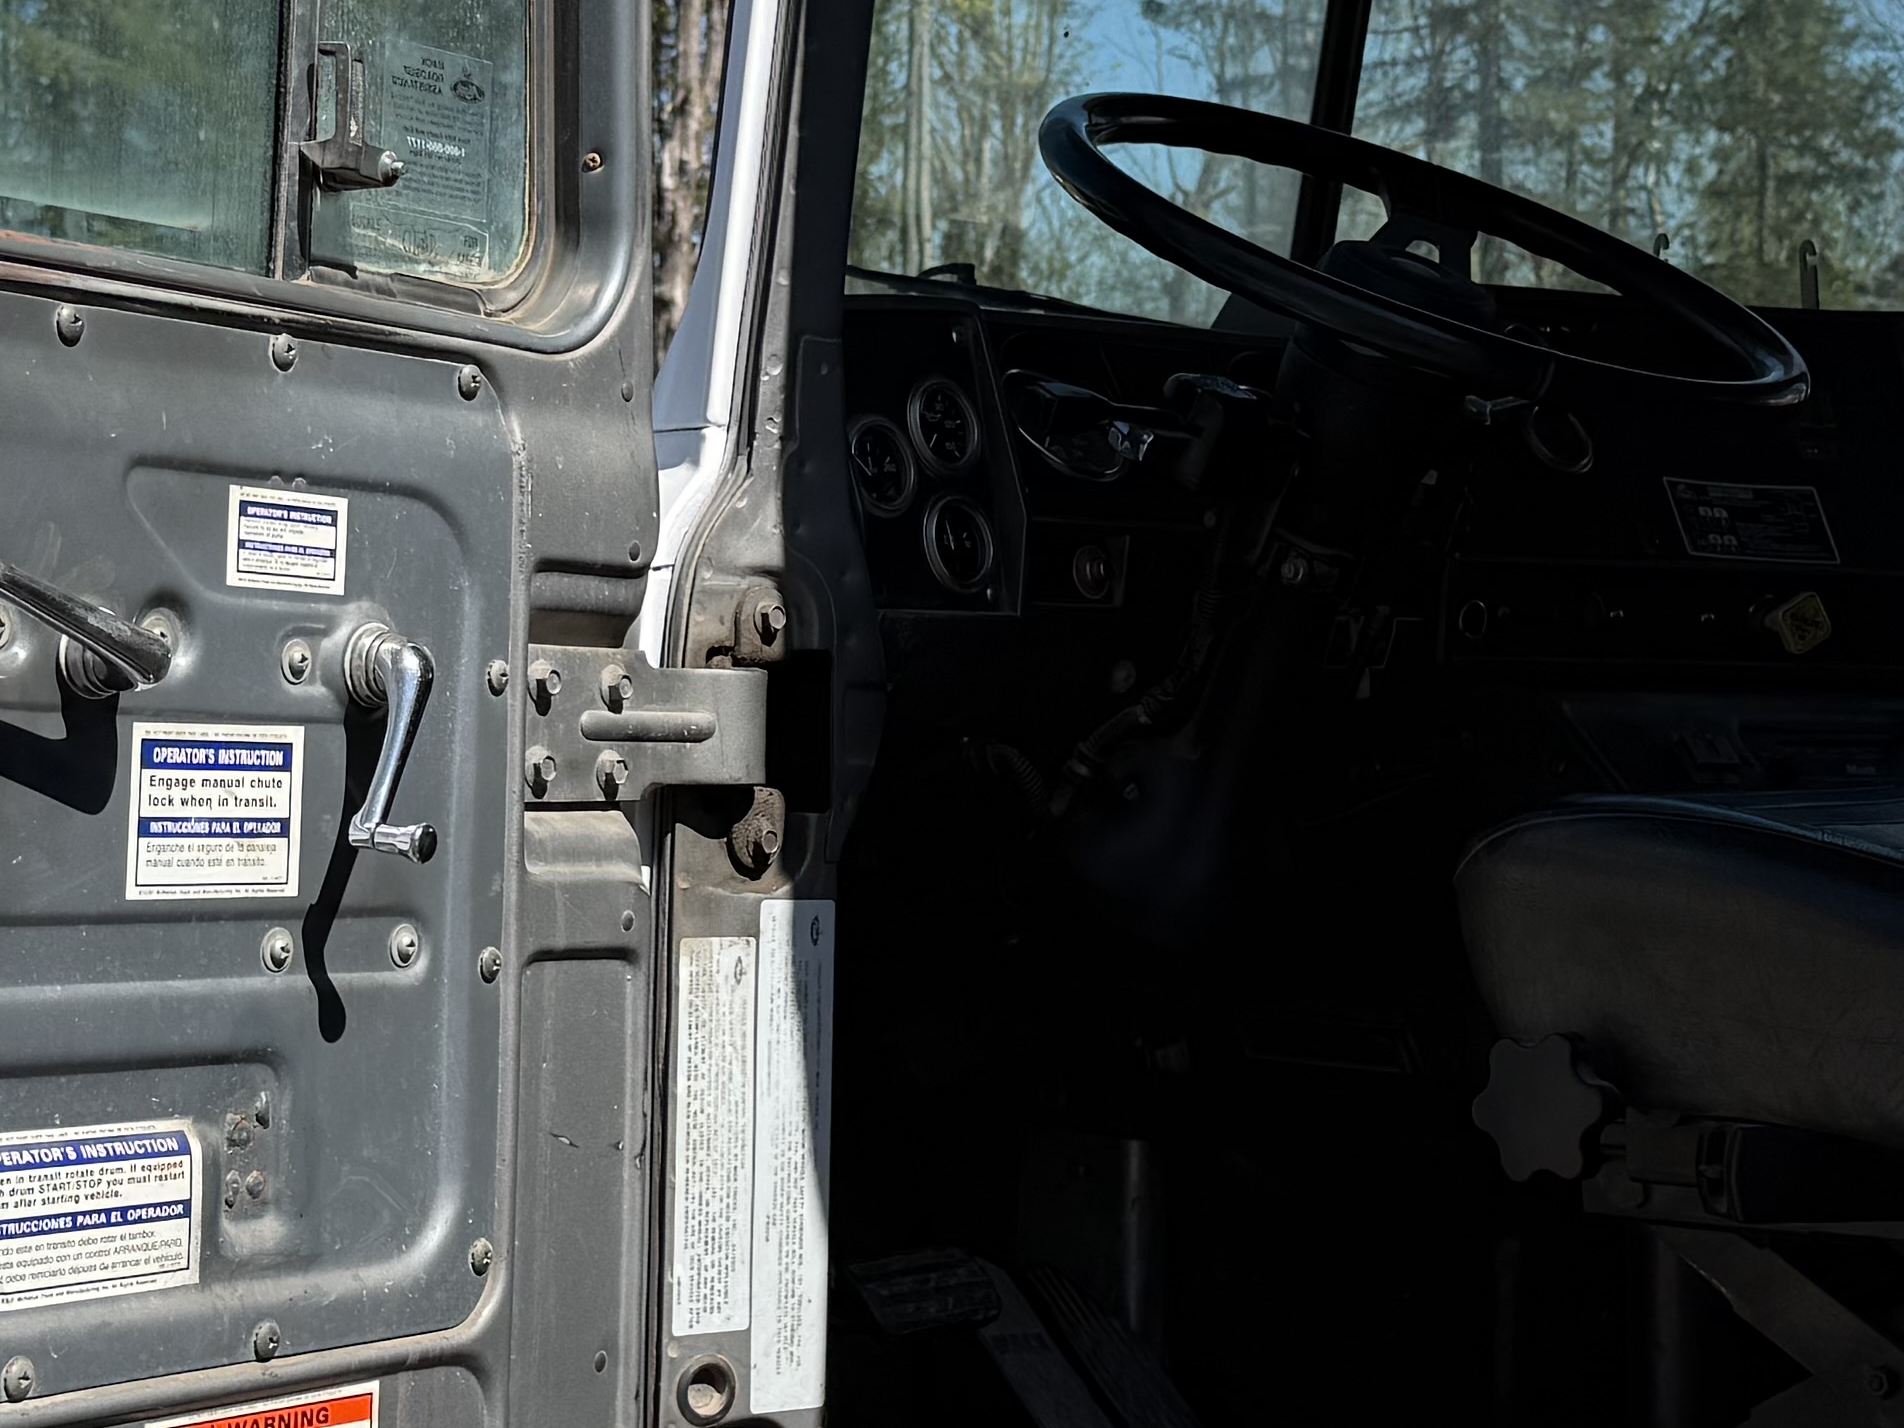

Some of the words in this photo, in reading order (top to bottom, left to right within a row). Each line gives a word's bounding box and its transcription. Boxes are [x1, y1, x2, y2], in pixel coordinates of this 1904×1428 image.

[152, 747, 215, 764] OPERATOR'S
[218, 749, 283, 766] INSTRUCTION
[149, 775, 196, 790] Engage
[201, 776, 244, 788] manual
[250, 776, 282, 788] chute
[148, 794, 174, 806] lock
[180, 794, 212, 806] when
[218, 794, 228, 806] in
[234, 794, 277, 807] transit.
[211, 821, 230, 833] PARA
[80, 1136, 178, 1159] INSTRUCTION
[15, 1174, 24, 1184] in
[28, 1170, 61, 1183] transit
[65, 1167, 94, 1179] rotate
[98, 1164, 125, 1176] drum.
[130, 1164, 136, 1172] If
[140, 1159, 183, 1173] equipped
[9, 1185, 34, 1196] drum
[38, 1178, 102, 1194] START/STOP
[106, 1177, 123, 1188] you
[127, 1174, 150, 1184] must
[153, 1170, 184, 1181] restart
[13, 1197, 36, 1209] after
[41, 1192, 80, 1207] starting
[84, 1188, 122, 1201] vehicle.
[75, 1212, 106, 1227] PARA
[110, 1210, 122, 1223] EL
[126, 1203, 183, 1221] OPERADOR
